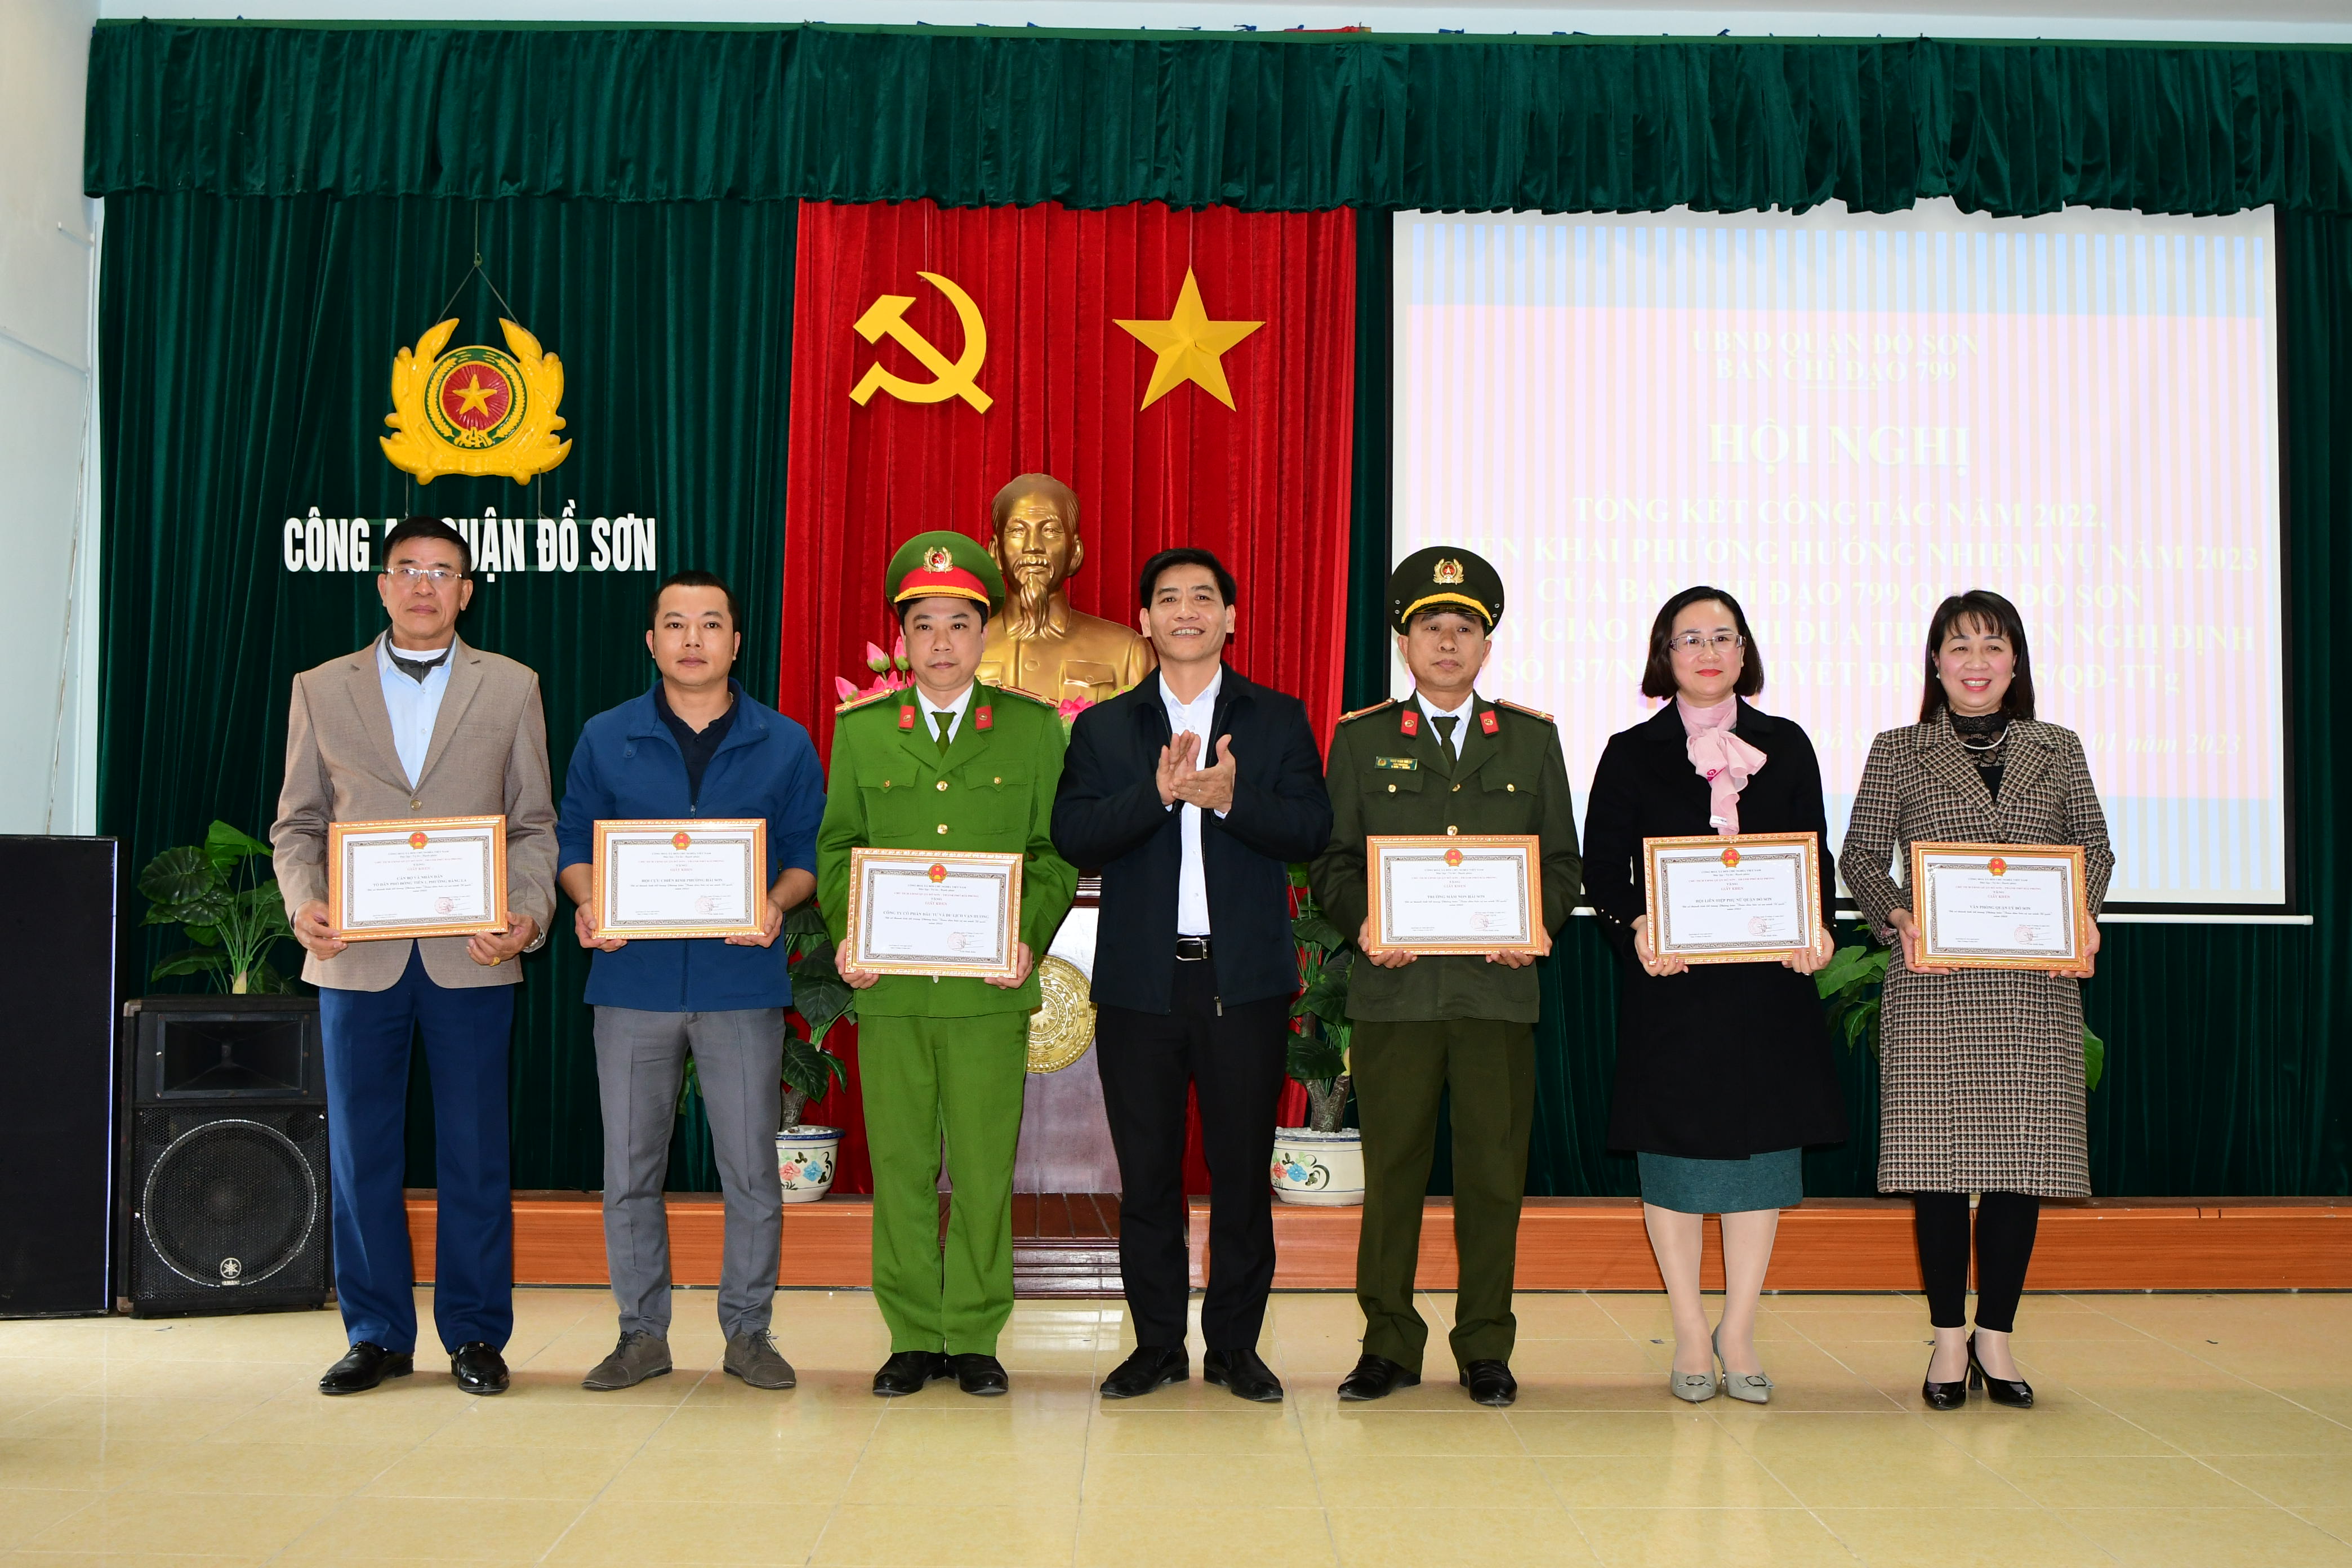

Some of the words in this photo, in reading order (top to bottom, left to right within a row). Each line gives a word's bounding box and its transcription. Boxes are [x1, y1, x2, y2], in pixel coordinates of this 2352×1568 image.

[1693, 330, 1772, 353] UBND
[1780, 329, 1864, 358] QUẬN
[1873, 328, 1913, 355] ĐỒ
[1921, 332, 1980, 355] SƠN
[1716, 358, 1773, 380] BAN
[1783, 354, 1836, 380] CHỈ
[1846, 359, 1908, 387] ĐẠO
[1914, 360, 1957, 382] 799
[1707, 417, 1812, 474] HỘI
[1828, 424, 1971, 477] NGHỊ
[1572, 491, 1669, 523] TỔNG
[1680, 492, 1749, 523] KẾT
[1758, 493, 1857, 525] CÔNG
[1866, 495, 1935, 527] TÁC
[1945, 497, 2023, 527] NĂM
[2033, 503, 2109, 532] 2022,
[284, 506, 369, 572] CÔNG
[537, 499, 580, 572] ĐỒ
[591, 513, 656, 572] SƠN
[1534, 538, 1620, 562] KHAI
[1631, 536, 1779, 564] PHƯƠNG
[1791, 535, 1916, 565] HƯỚNG
[1927, 539, 2042, 573] NHIỆM
[2052, 543, 2096, 574] VỤ
[2109, 539, 2185, 569] NĂM
[2195, 546, 2259, 571] 2023
[1536, 570, 1609, 603] CỦA
[1703, 572, 1758, 605] HỈ
[1767, 581, 1843, 613] ĐẠO
[1851, 581, 1901, 606] 799
[2017, 576, 2066, 608] ĐỒ
[2075, 582, 2142, 608] SƠN
[1539, 618, 1628, 642] GIAO
[1748, 620, 1781, 645] HI
[1793, 621, 1864, 645] ĐUA
[2075, 623, 2159, 654] NGHỊ
[2171, 625, 2253, 656] ĐỊNH
[1500, 651, 1544, 683] SỐ
[1766, 654, 1858, 685] UYẾT
[1866, 662, 1925, 693] ĐỊN
[2091, 732, 2117, 753] 01
[2126, 732, 2178, 754] năm
[2185, 733, 2241, 755] 2023
